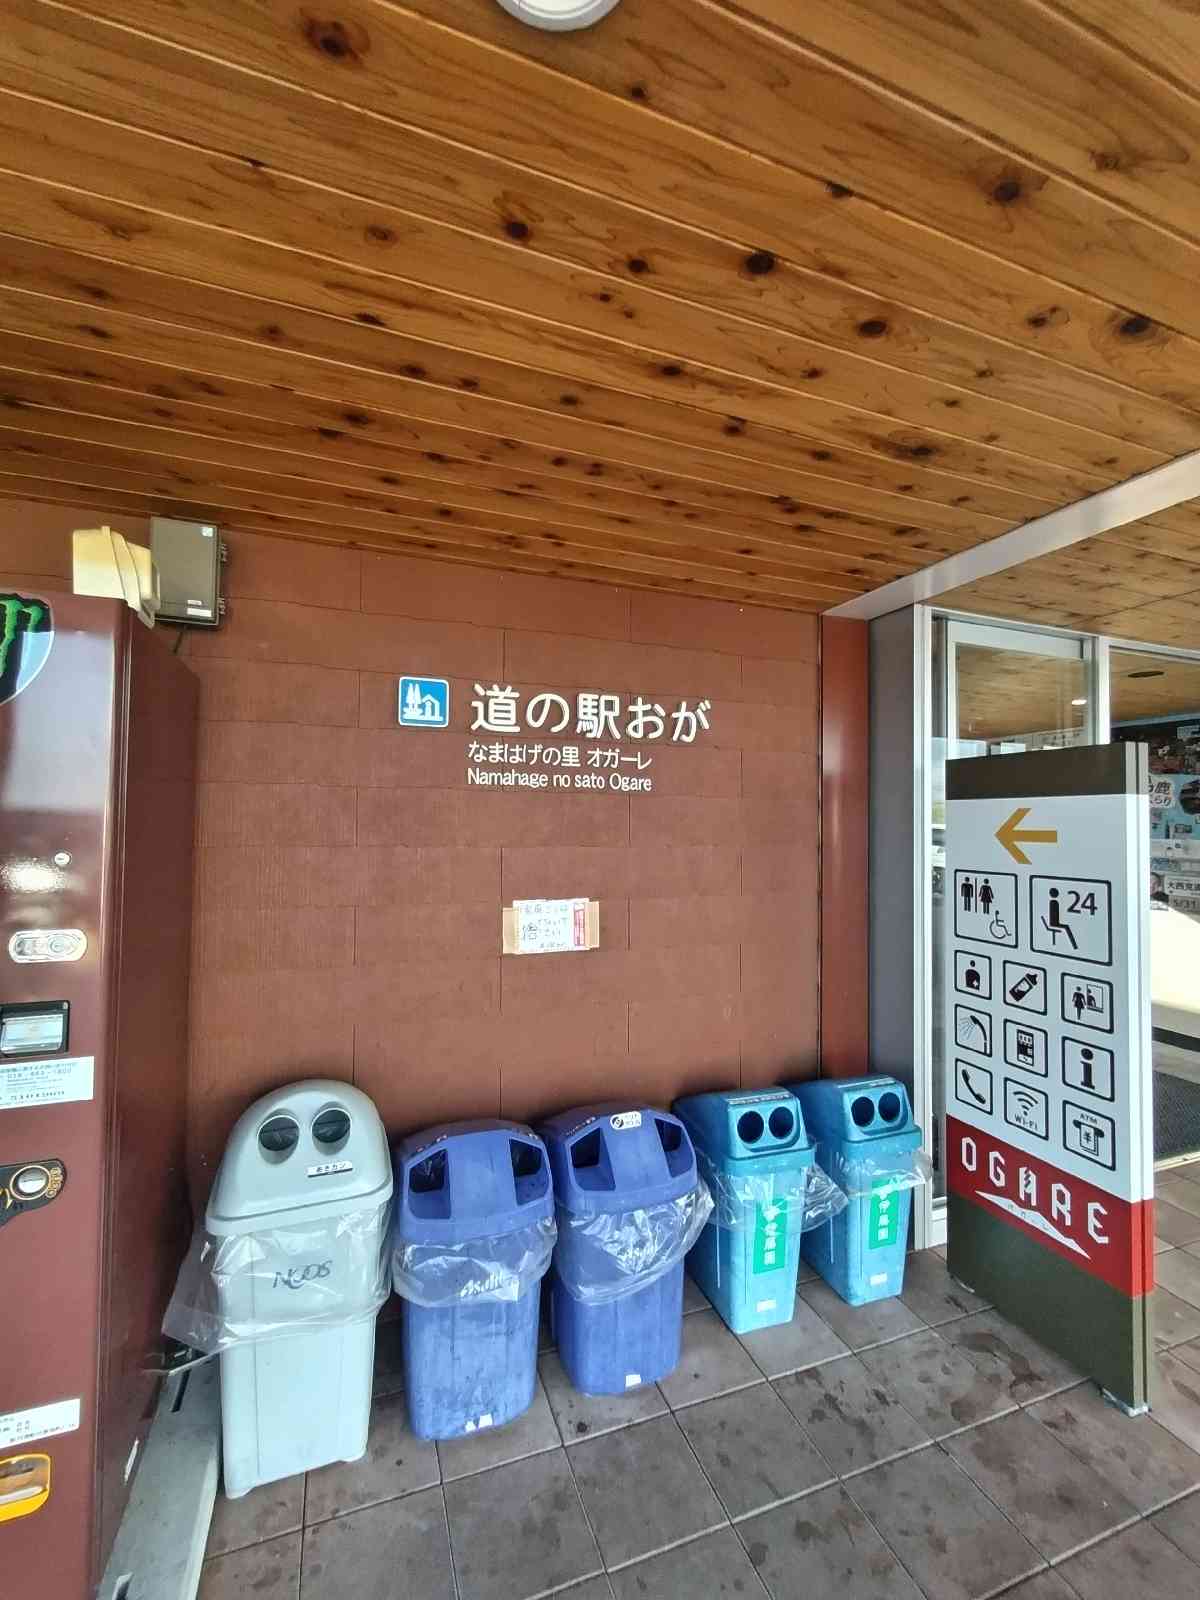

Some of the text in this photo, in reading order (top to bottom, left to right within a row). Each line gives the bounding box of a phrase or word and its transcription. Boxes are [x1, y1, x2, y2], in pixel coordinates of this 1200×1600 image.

[470, 683, 711, 743] 道の駅おが
[468, 740, 653, 770] なまはげの里 オガーレ
[467, 767, 652, 792] Namahage no sato Ogare
[1067, 890, 1097, 915] 24
[961, 1136, 1109, 1244] OGARE
